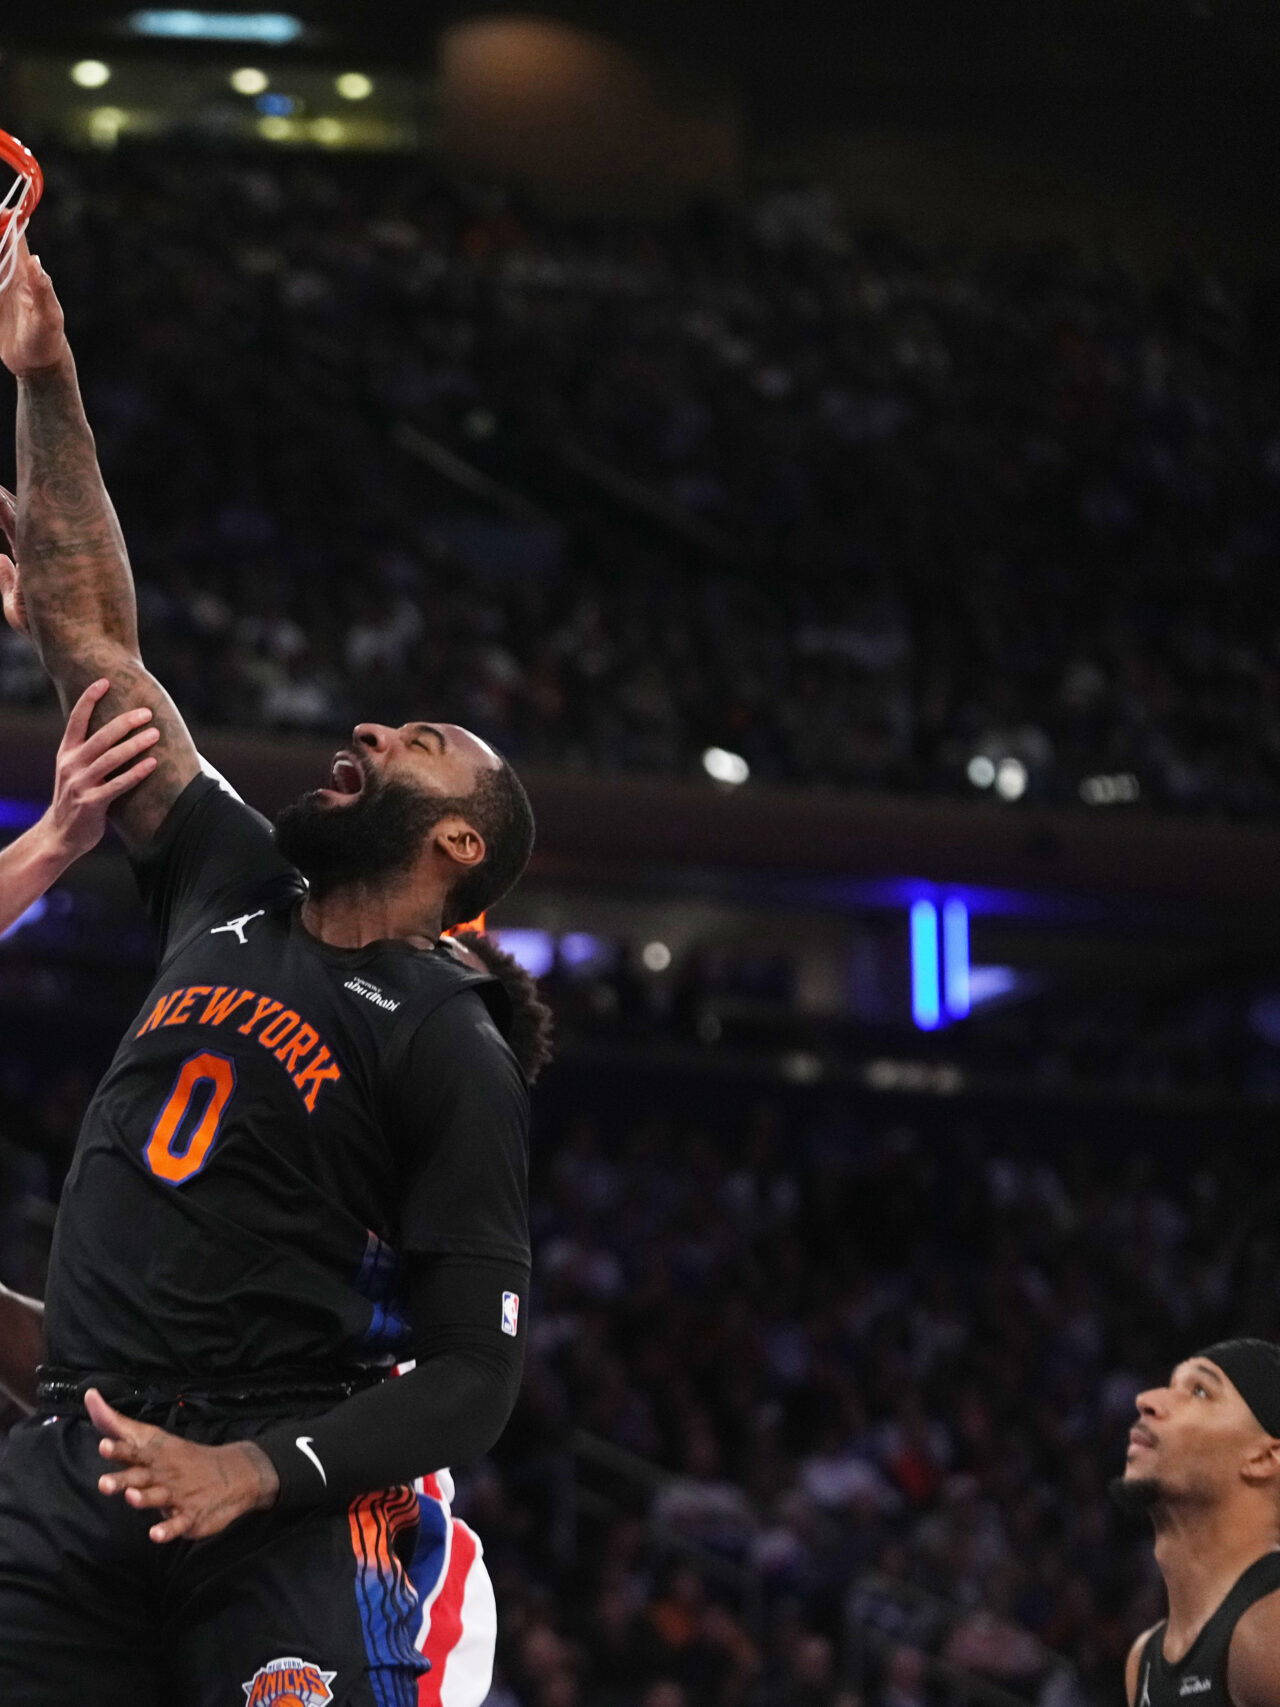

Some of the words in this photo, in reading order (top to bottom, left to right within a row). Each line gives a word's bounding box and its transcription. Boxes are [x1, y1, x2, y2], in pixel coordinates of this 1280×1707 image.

[135, 985, 257, 1039] NEW
[237, 996, 341, 1114] YORK
[143, 1048, 238, 1187] 0
[248, 1666, 330, 1707] KNICKS
